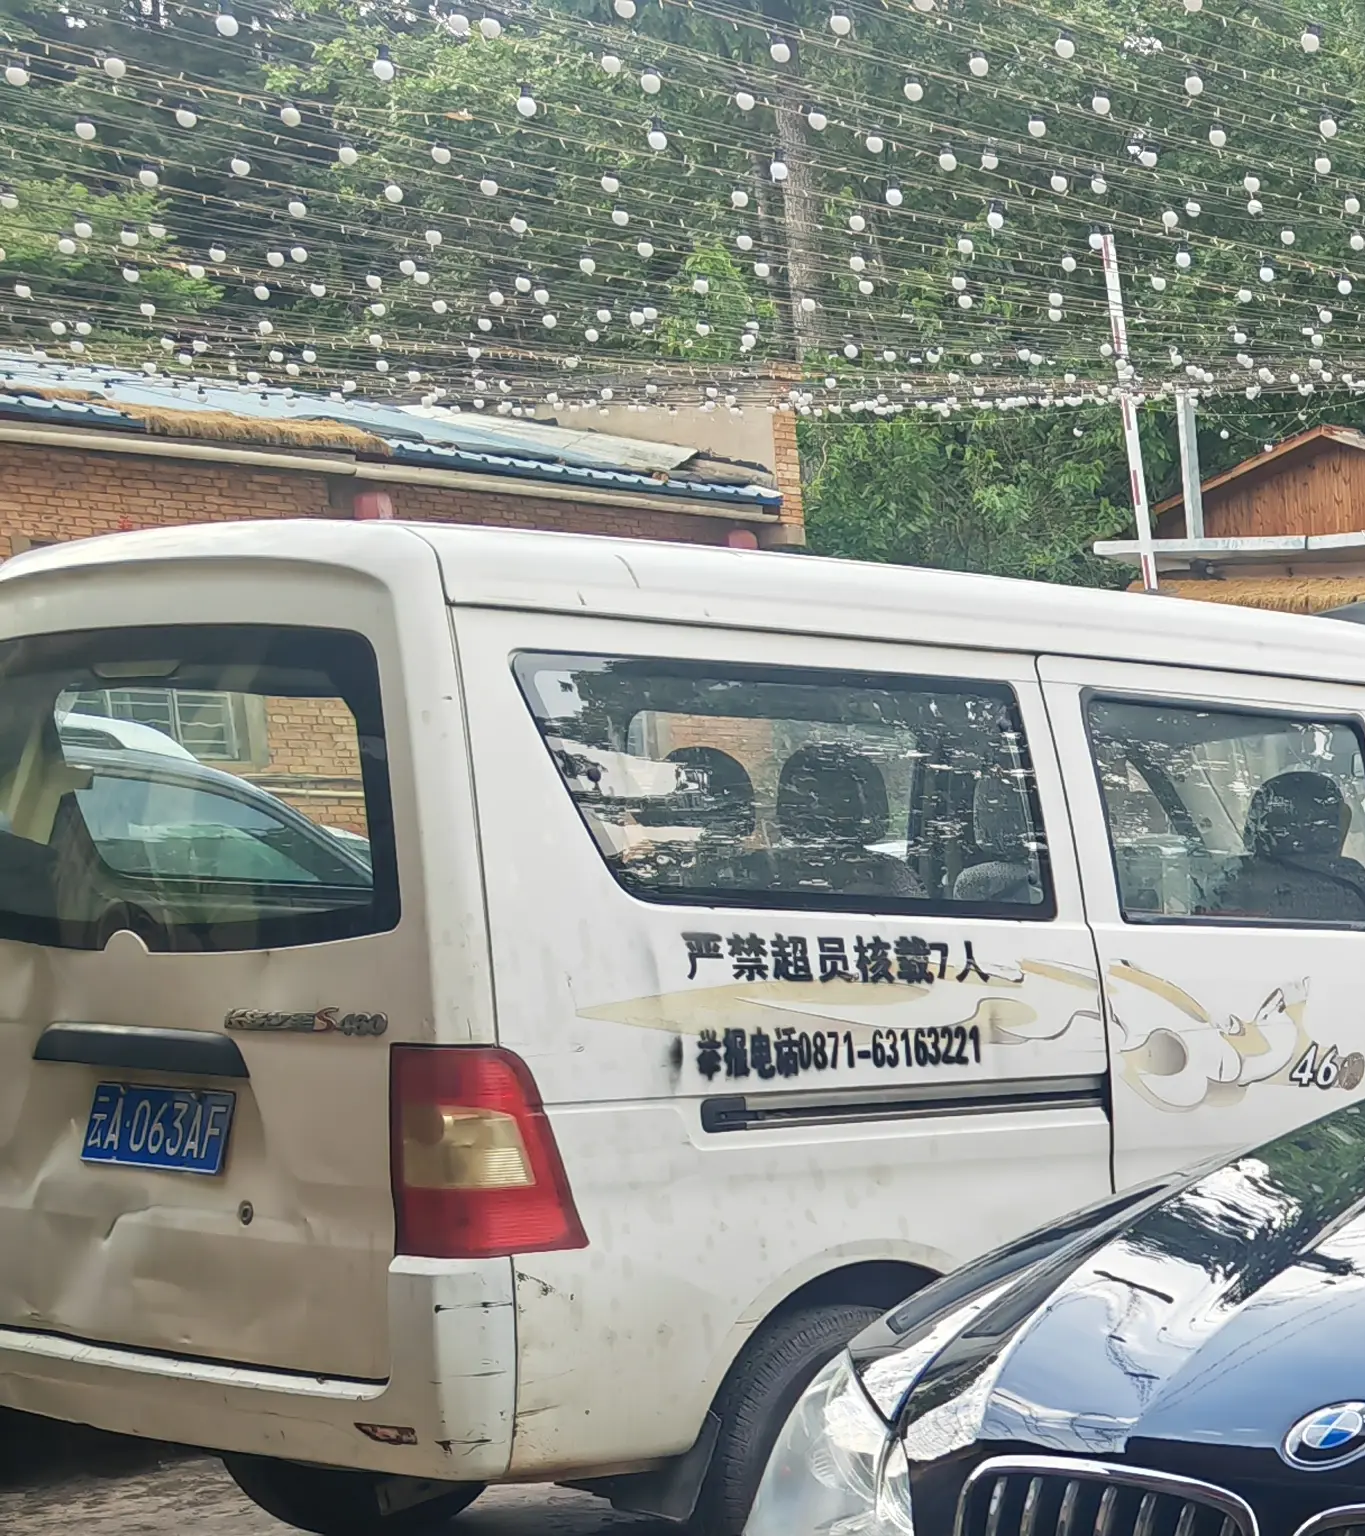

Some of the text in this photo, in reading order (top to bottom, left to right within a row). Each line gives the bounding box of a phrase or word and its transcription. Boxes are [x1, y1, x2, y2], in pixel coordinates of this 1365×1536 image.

[681, 931, 990, 984] 严禁超员核载7人
